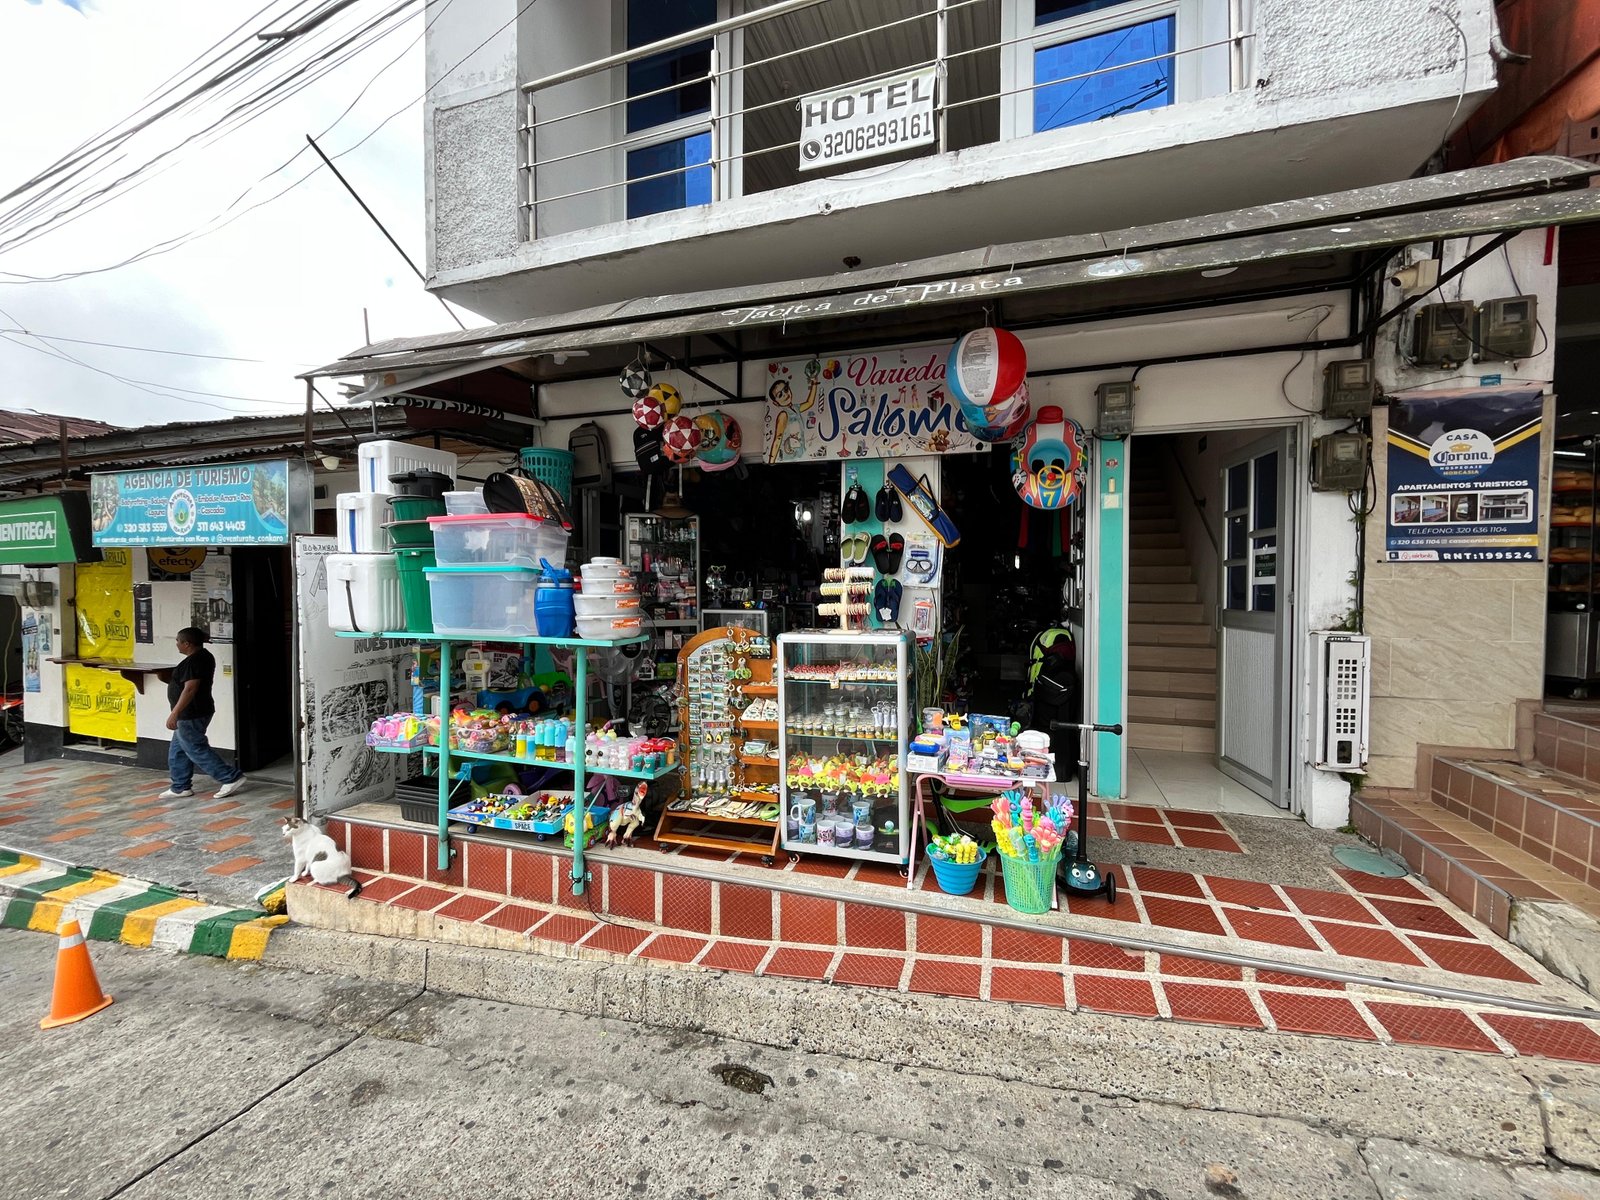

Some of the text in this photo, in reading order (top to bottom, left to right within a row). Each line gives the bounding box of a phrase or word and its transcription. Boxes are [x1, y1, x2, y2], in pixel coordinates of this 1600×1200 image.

[804, 77, 931, 128] HOTEL
[823, 111, 932, 159] 3206293161
[720, 302, 832, 325] Tacita
[853, 293, 888, 306] de
[887, 275, 1024, 303] Plata
[847, 354, 946, 387] Varieda
[1446, 433, 1479, 441] CASA
[124, 466, 252, 490] AGENCIA DE TURISMO
[1397, 479, 1529, 491] APARTAMENTOS TURISTICOS
[1043, 490, 1056, 507] 7
[0, 520, 54, 542] ENTREGA
[225, 520, 246, 531] 4403
[158, 556, 198, 569] efecty
[514, 822, 532, 831] SPACE
